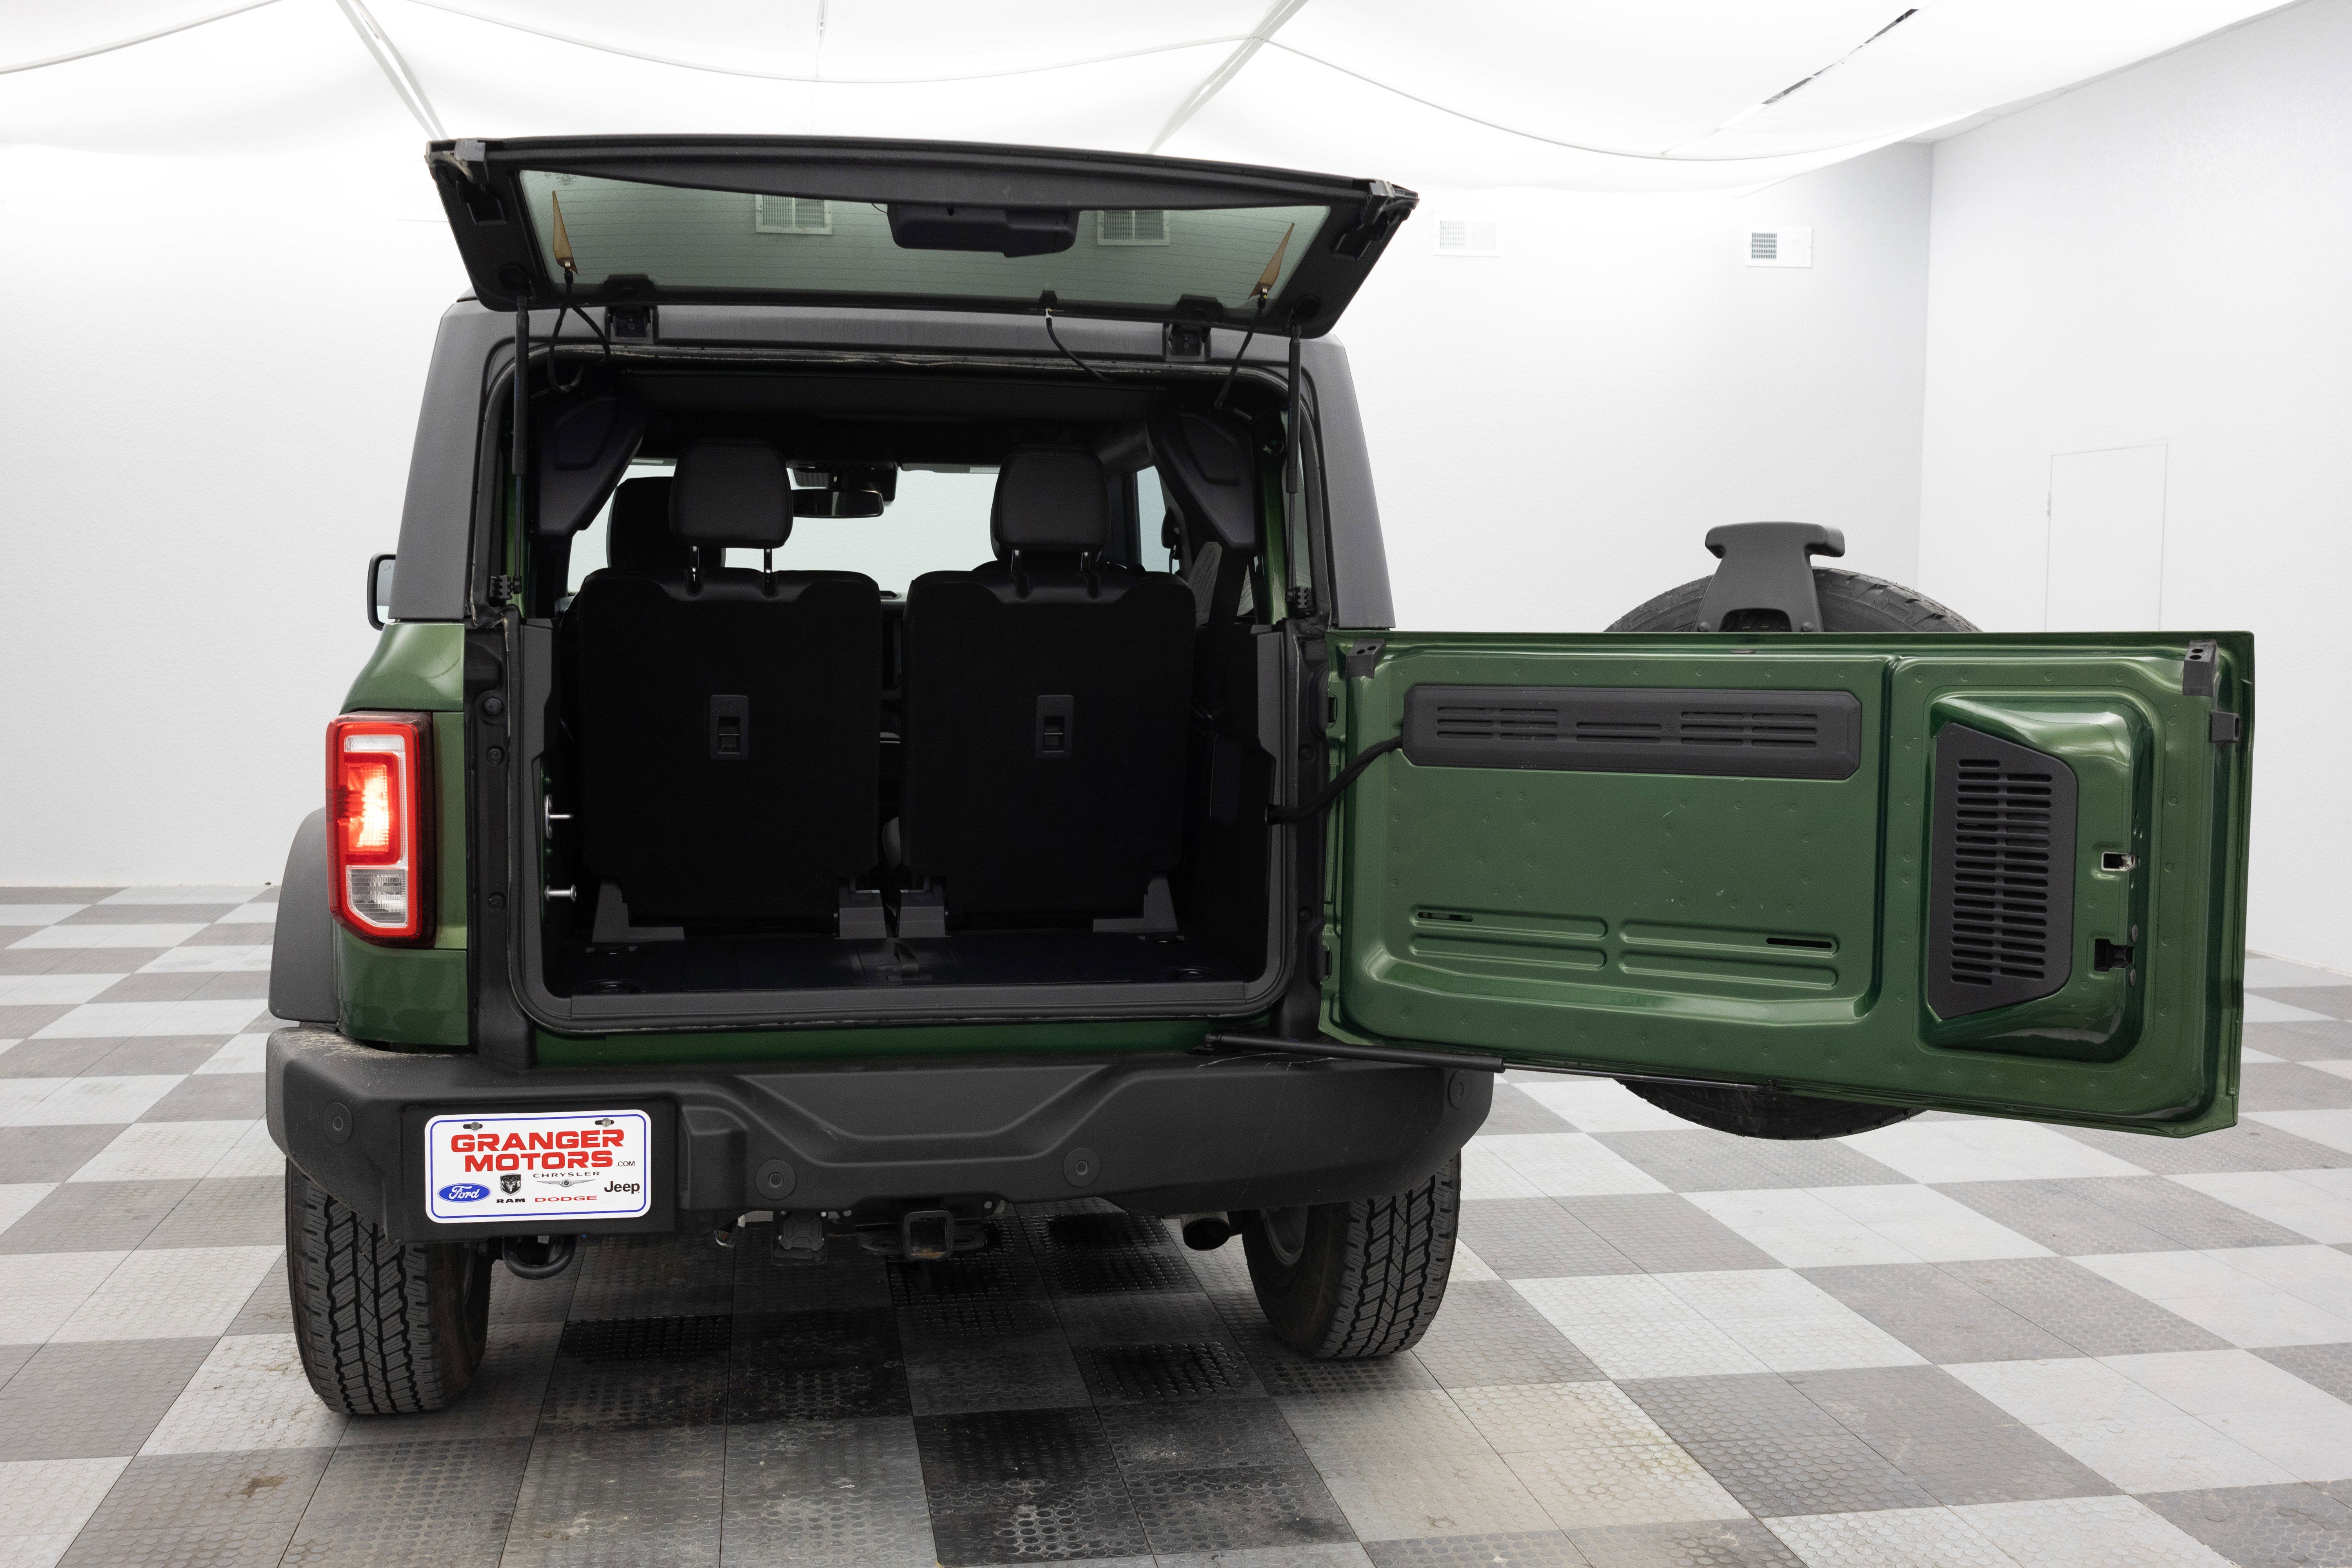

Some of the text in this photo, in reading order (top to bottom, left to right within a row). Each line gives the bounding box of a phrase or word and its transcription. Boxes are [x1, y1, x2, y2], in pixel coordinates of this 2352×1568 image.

[451, 1129, 624, 1152] GRANGER
[465, 1150, 613, 1172] MOTORS
[449, 1185, 480, 1200] Ford
[604, 1181, 640, 1194] Jeep
